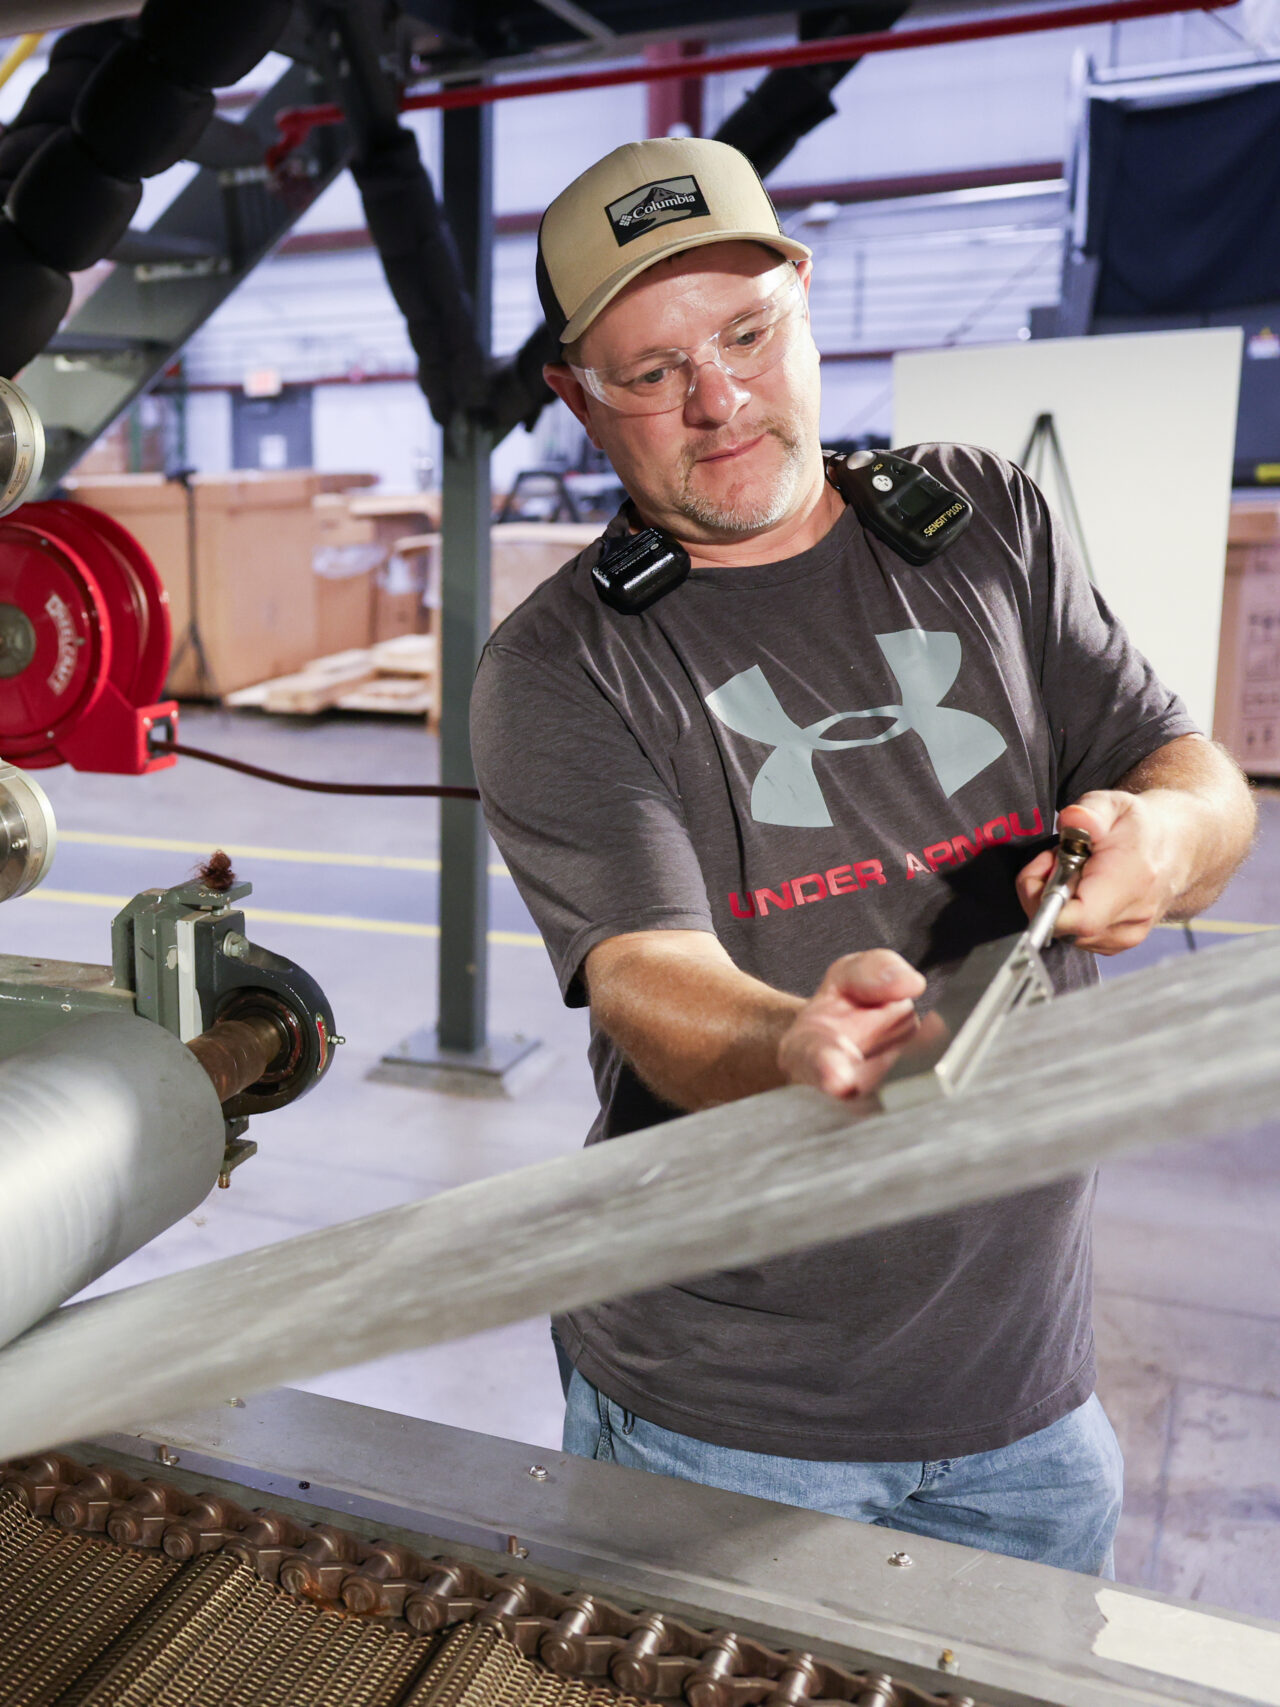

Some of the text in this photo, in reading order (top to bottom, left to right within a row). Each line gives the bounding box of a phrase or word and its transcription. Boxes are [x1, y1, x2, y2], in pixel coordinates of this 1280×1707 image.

[633, 194, 696, 219] Columbia
[923, 503, 962, 536] SENSIT P100
[728, 808, 1043, 918] UNDER ARMOU
